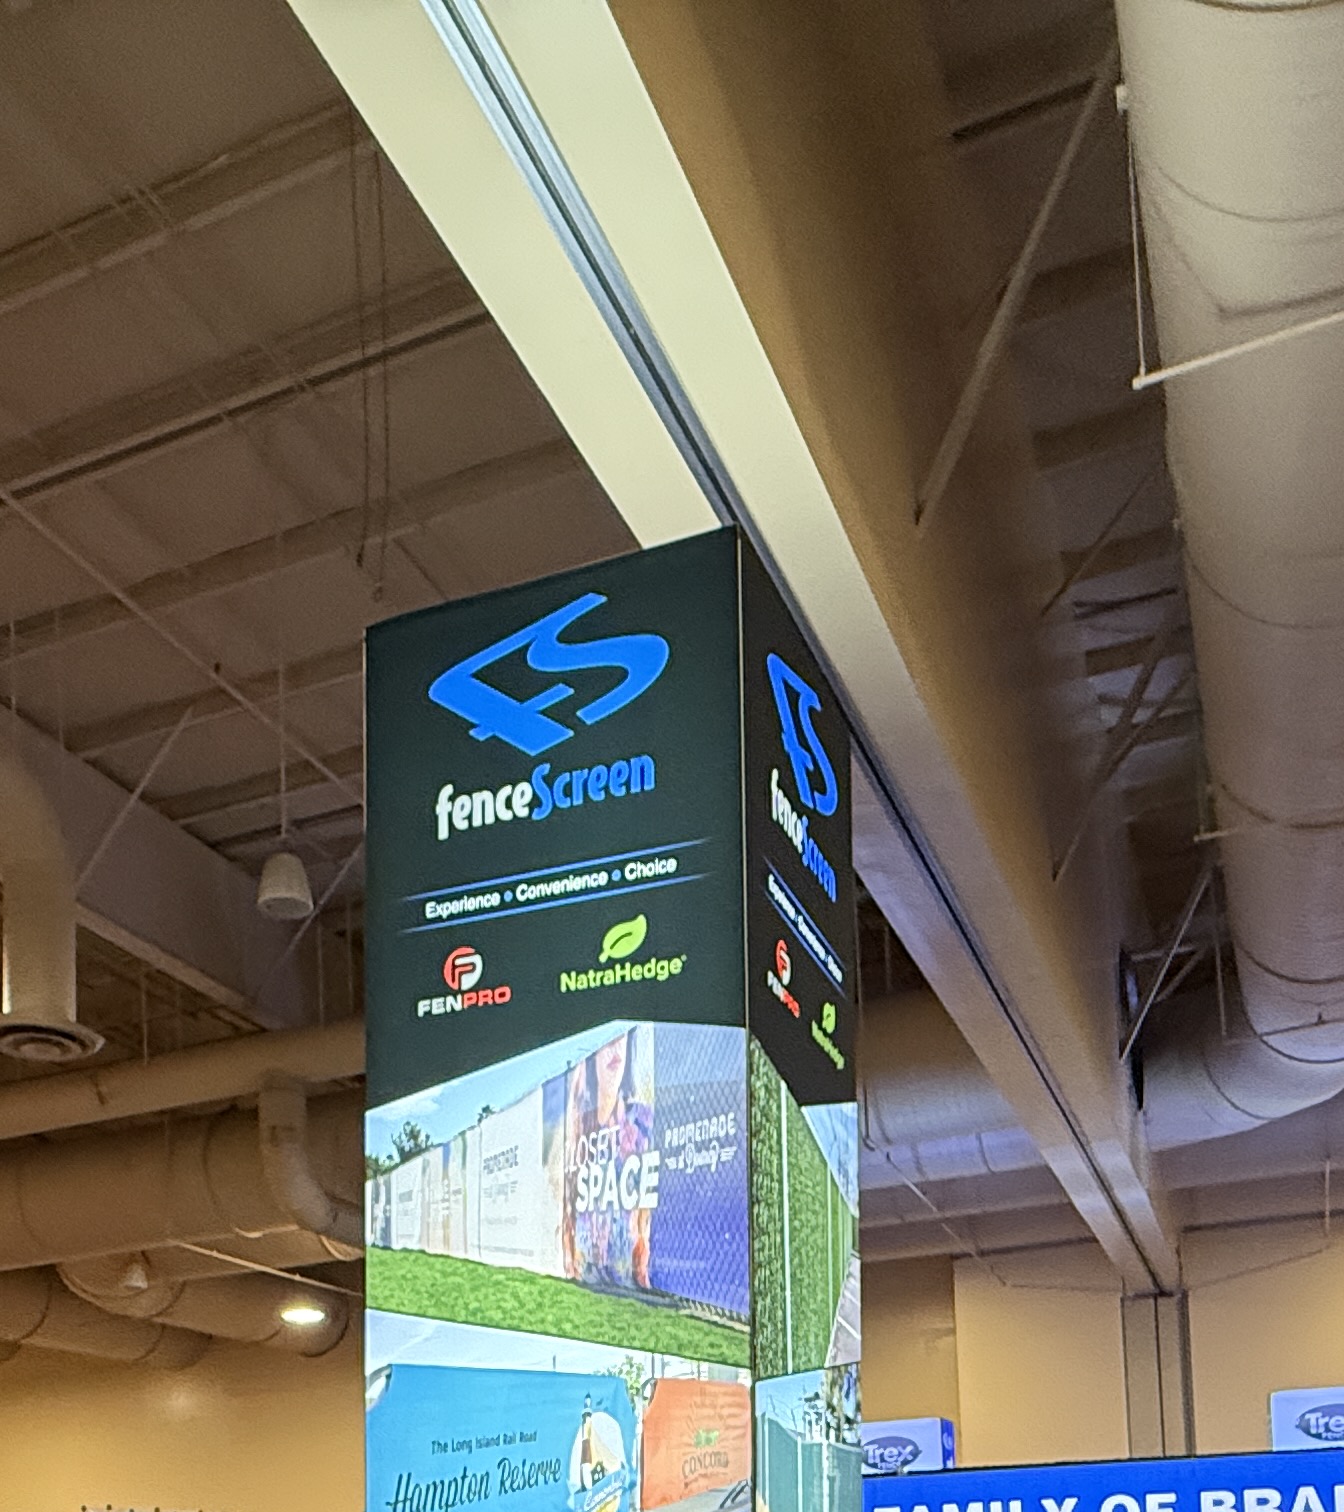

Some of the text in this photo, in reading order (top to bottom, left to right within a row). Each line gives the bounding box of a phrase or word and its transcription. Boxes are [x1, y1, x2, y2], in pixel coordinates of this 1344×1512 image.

[435, 754, 655, 841] fenceScreen
[425, 857, 678, 919] Experience Convenience Choice
[560, 955, 686, 993] NatraHedge
[417, 986, 512, 1018] FENPRO
[574, 1150, 660, 1213] SPACE
[431, 1440, 449, 1455] The
[452, 1437, 473, 1454] Long
[862, 1436, 915, 1464] Trex
[497, 1456, 562, 1497] Reserve
